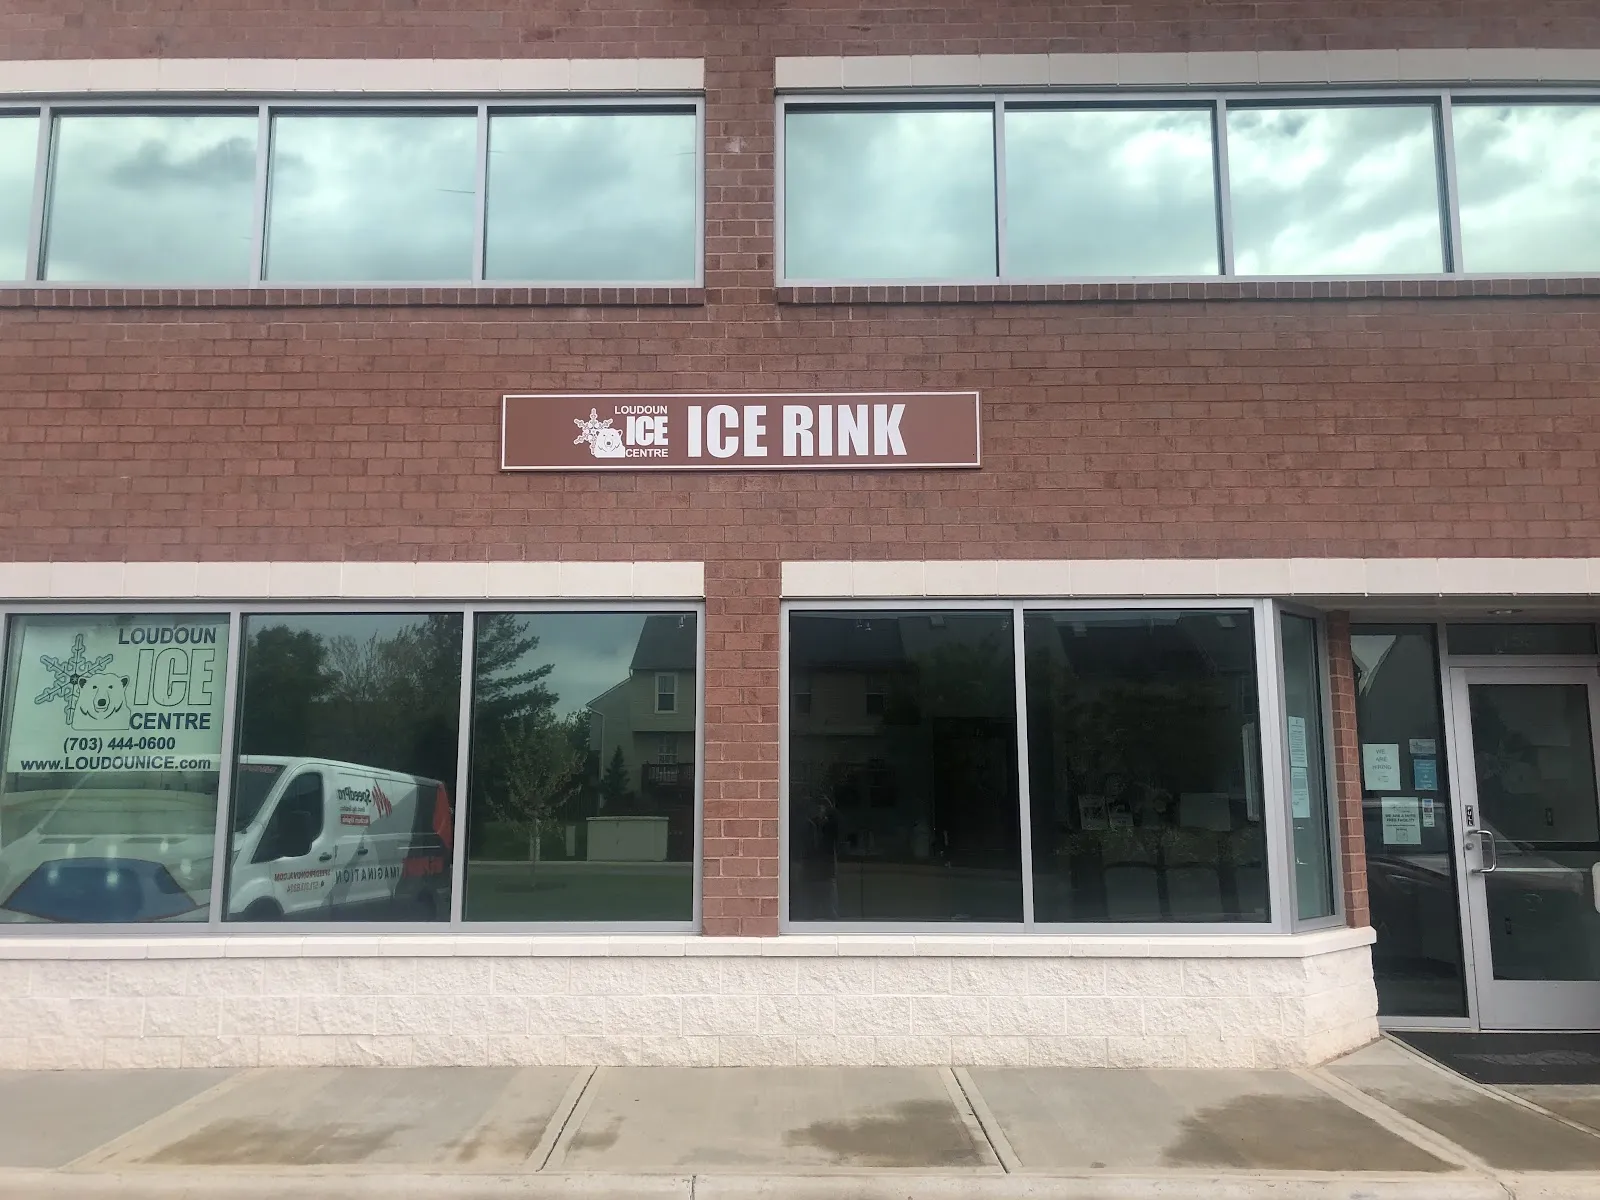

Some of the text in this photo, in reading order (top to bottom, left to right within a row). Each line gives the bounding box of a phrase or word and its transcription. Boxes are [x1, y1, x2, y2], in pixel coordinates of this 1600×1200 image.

[614, 405, 668, 415] LOUDOUN
[626, 415, 669, 446] ICE
[687, 403, 908, 458] ICE RINK
[625, 448, 669, 458] CENTRE
[118, 627, 217, 645] LOUDOUN
[133, 647, 215, 707] ICE
[129, 712, 211, 730] CENTRE
[63, 736, 176, 753] (703) 444-0600
[20, 755, 211, 770] www.LOUDOUNICE.com
